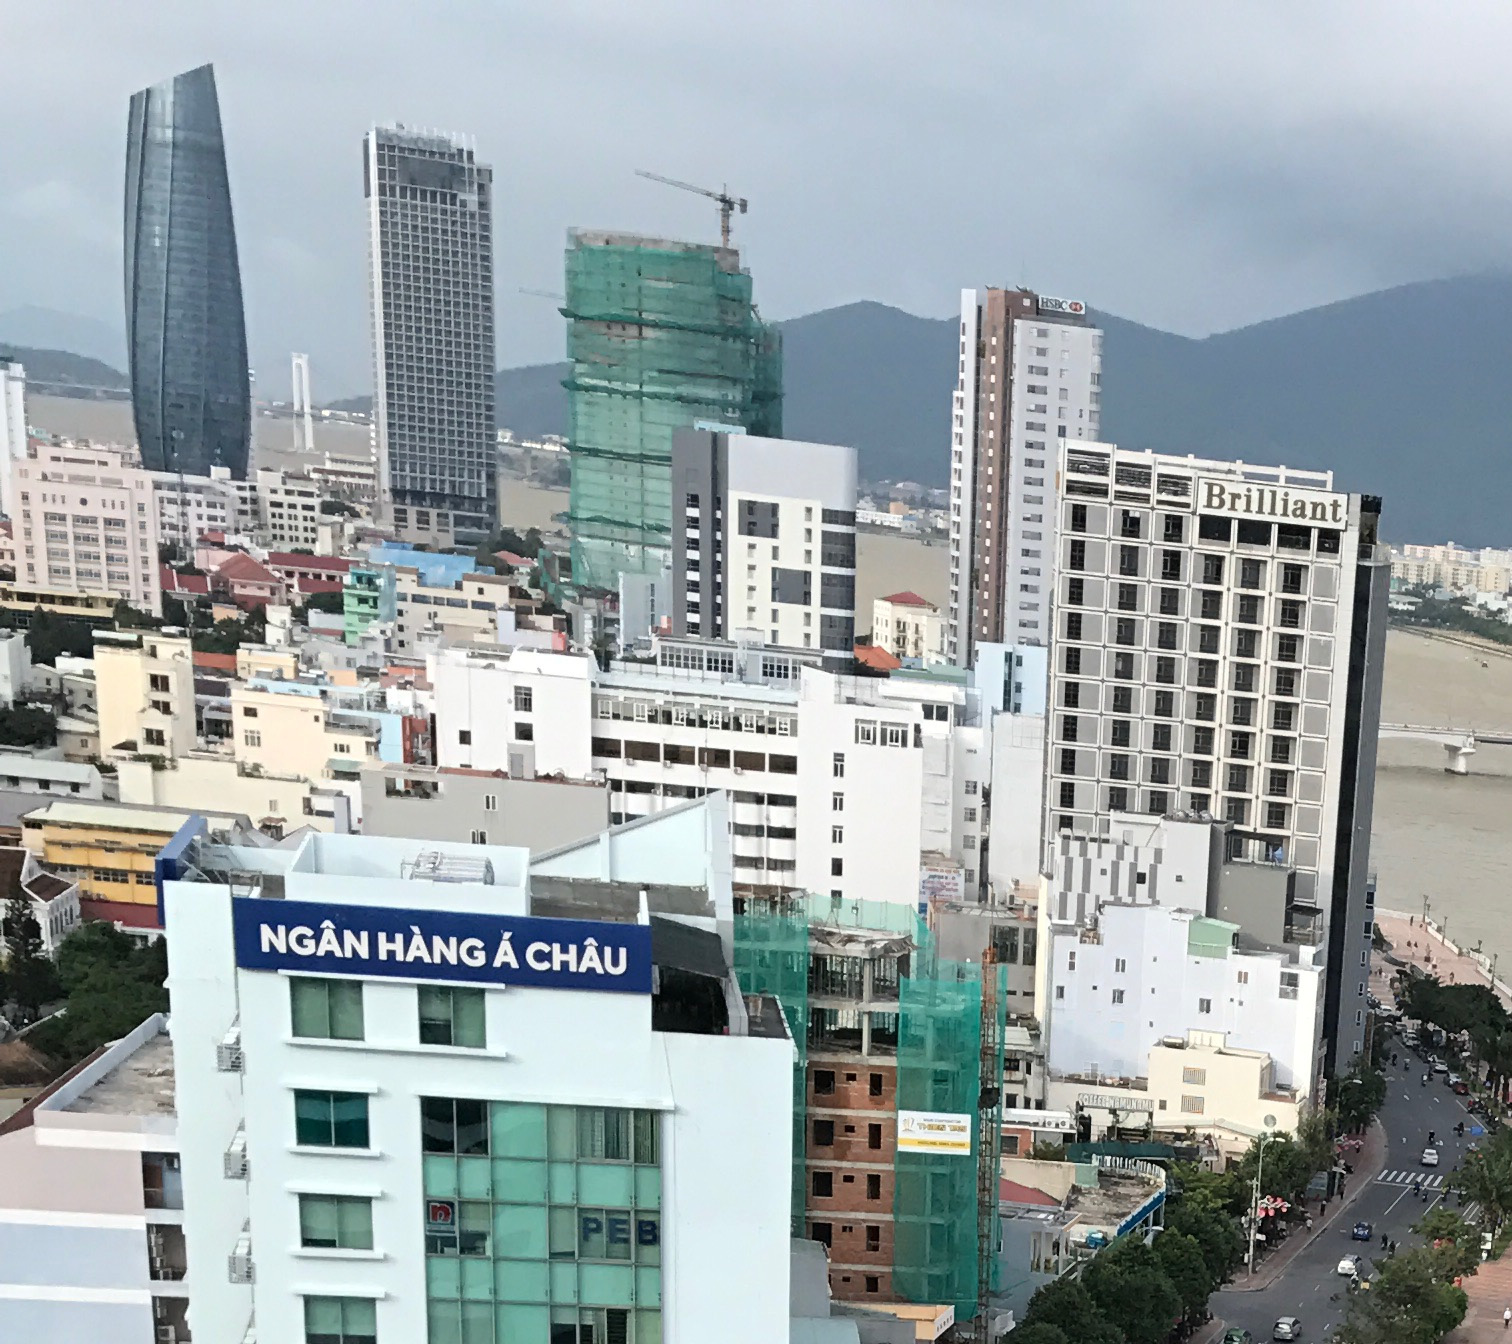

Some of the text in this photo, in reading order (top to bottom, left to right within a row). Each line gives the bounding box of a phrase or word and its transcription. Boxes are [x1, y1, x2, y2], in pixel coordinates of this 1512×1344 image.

[1041, 297, 1068, 310] HSBC
[1203, 482, 1342, 523] Brilliant
[260, 920, 627, 975] NGÂN HÀNG Á CHÂU
[582, 1216, 658, 1246] PEB
